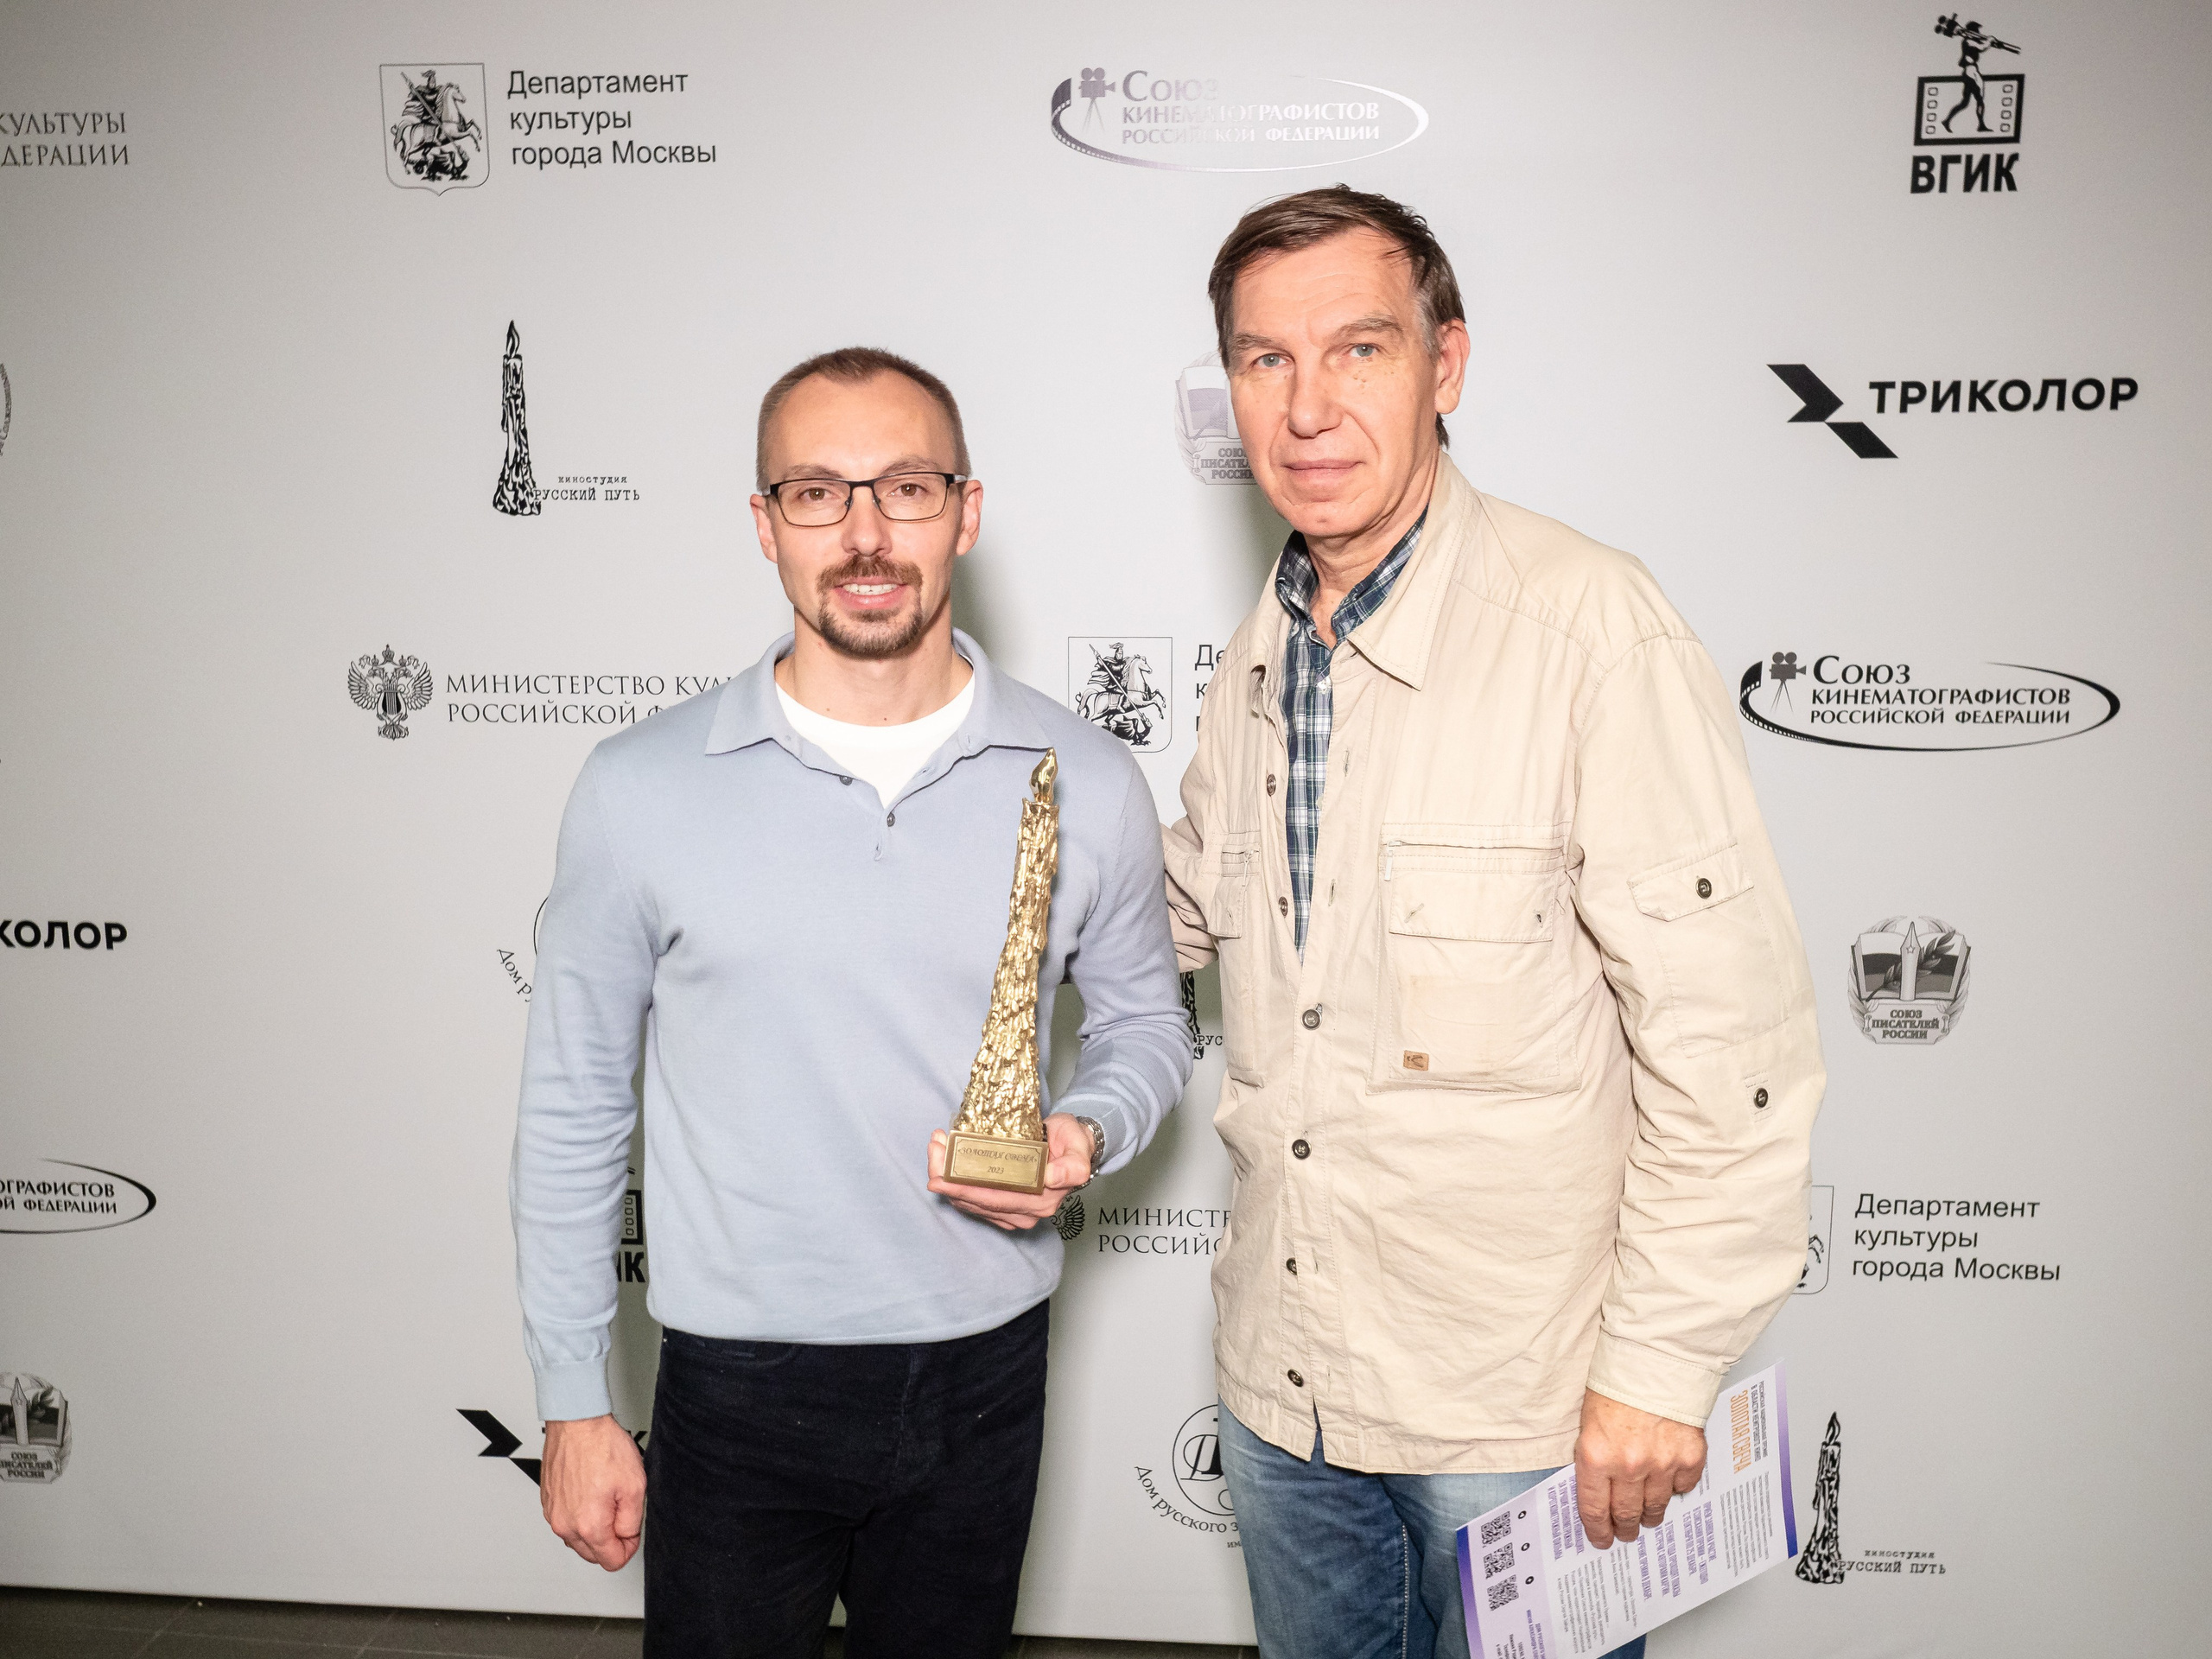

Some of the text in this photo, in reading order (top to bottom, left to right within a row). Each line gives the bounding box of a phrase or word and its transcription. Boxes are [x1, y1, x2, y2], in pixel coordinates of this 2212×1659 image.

[507, 70, 688, 99] Департамент
[1122, 70, 1218, 102] Союз
[510, 110, 632, 136] культуры
[1122, 102, 1380, 124] КИНЕМАТОГРАФИСТОВ
[1122, 125, 1380, 144] РОССИЙСКОЙ ФЕДЕРАЦИИ
[1, 143, 129, 168] ДЕРАЦИИ
[512, 140, 716, 170] города Москвы
[1910, 152, 2019, 194] ВГИК
[1868, 378, 2139, 414] ТРИКОЛОР
[1218, 448, 1247, 458] СОЮ
[558, 476, 627, 485] киностудия
[534, 487, 640, 501] РУССКИЙ ПУТЬ
[1813, 655, 1910, 685] Союз
[446, 674, 731, 696] МИНИСТЕРСТВО КУЛ
[1812, 687, 2070, 705] КИНЕМАТОГРАФИСТОВ
[448, 701, 637, 724] РОССИЙСКОЙ
[1810, 707, 2070, 724] РОССИЙСКОЙ ФЕДЕРАЦИИ
[496, 949, 523, 985] Дом
[1872, 1018, 1940, 1029] ПИСАТЕЛЕЙ
[1890, 1009, 1923, 1019] СОЮЗ
[1882, 1029, 1928, 1039] РОССИИ
[987, 1166, 1005, 1175] 2023
[23, 1198, 118, 1214] ФЕДЕРАЦИИ
[1854, 1193, 2040, 1221] Департамент
[1854, 1229, 1978, 1252] культуры
[1853, 1257, 2061, 1281] города Москвы
[1731, 1390, 1751, 1473] ЗОЛОТАЯ СВЕЧА
[1135, 1466, 1227, 1533] Дом русского
[1865, 1549, 1936, 1560] киностудия
[1838, 1560, 1946, 1574] РУССКИЙ ПУТЬ
